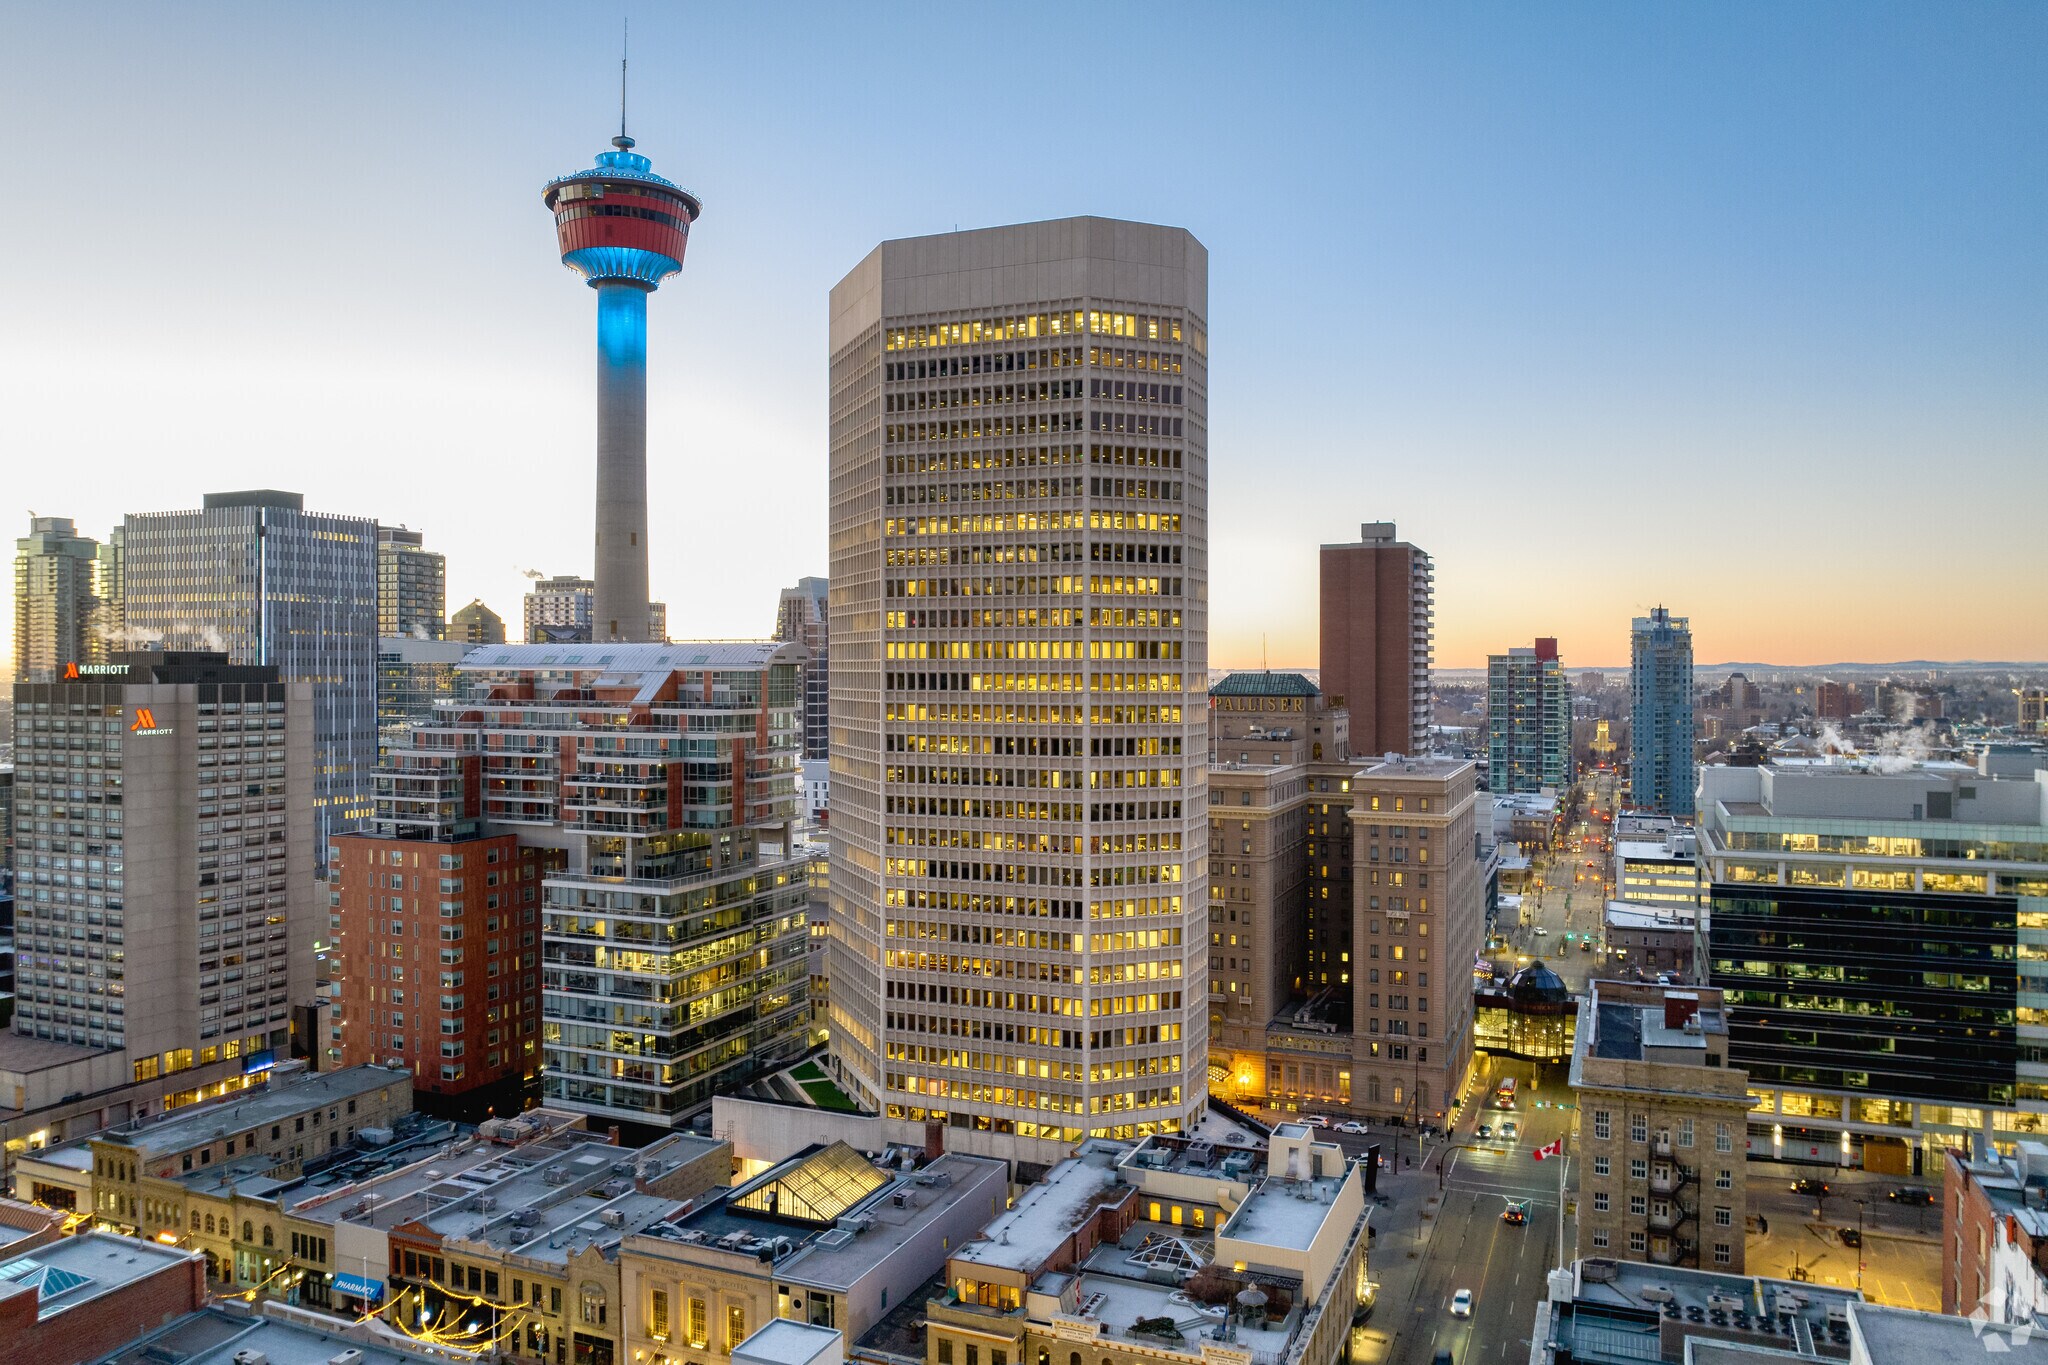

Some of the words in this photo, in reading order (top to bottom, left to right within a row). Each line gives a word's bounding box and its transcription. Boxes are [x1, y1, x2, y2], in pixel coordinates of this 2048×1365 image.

[79, 664, 130, 675] MARRIOTT
[1216, 697, 1304, 712] PALLISER
[136, 728, 174, 736] MARRIOTT
[335, 1280, 376, 1296] PHARMACY
